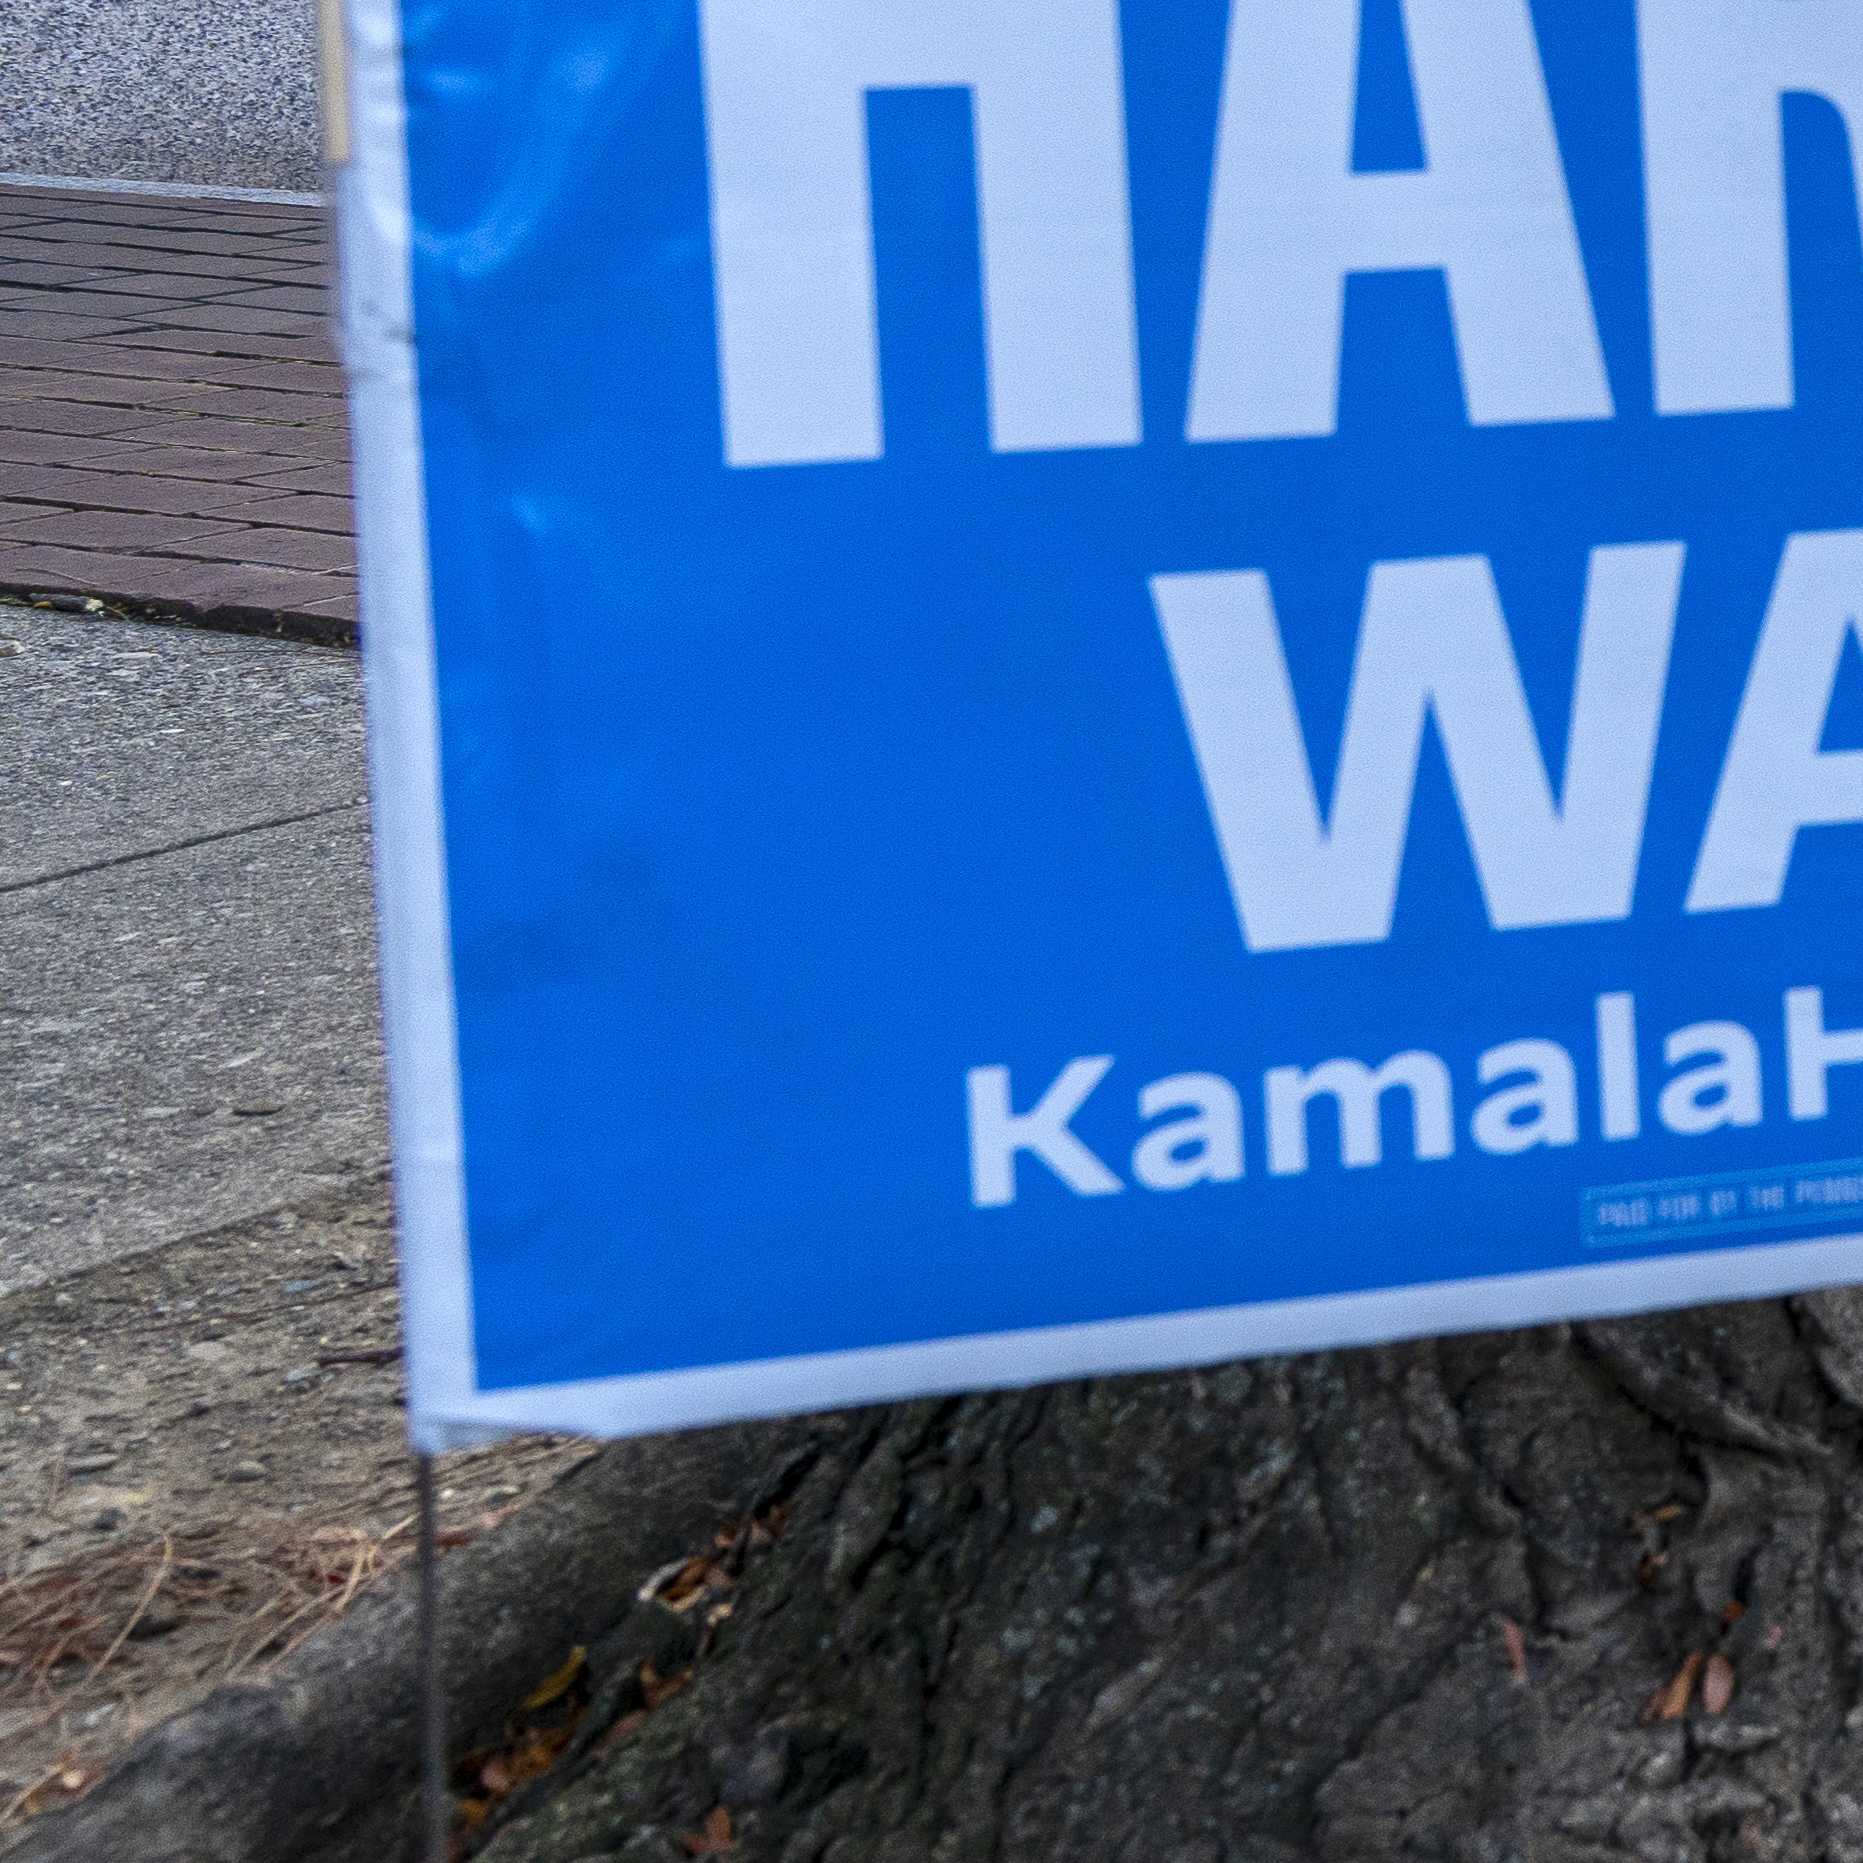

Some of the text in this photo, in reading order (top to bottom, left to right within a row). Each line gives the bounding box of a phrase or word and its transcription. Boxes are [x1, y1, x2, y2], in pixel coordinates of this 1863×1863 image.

[1597, 1197, 1649, 1228] PAID
[1657, 1193, 1701, 1221] FOR
[1749, 1185, 1785, 1211] THE
